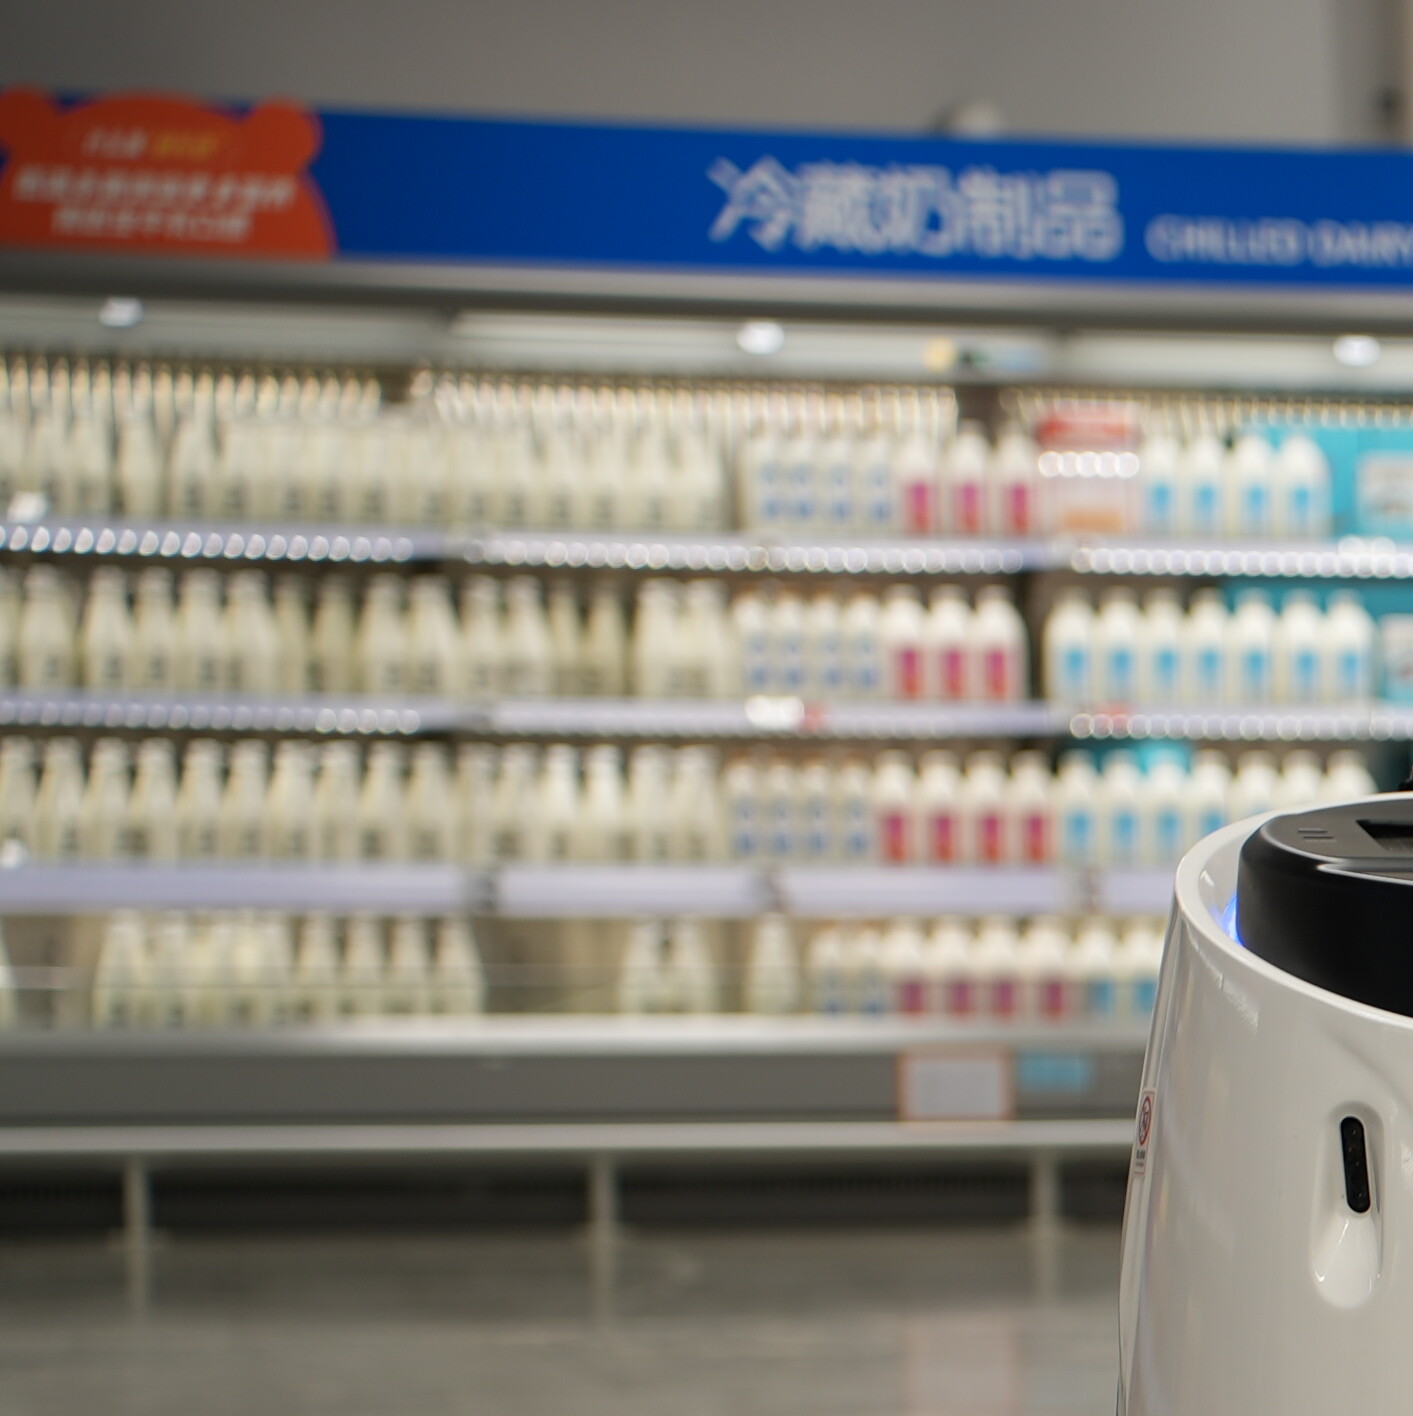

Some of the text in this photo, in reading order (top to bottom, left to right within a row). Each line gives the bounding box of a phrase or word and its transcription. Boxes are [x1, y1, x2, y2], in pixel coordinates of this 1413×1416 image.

[706, 157, 1122, 260] 冷藏奶制品
[1146, 215, 1306, 264] CHILLED
